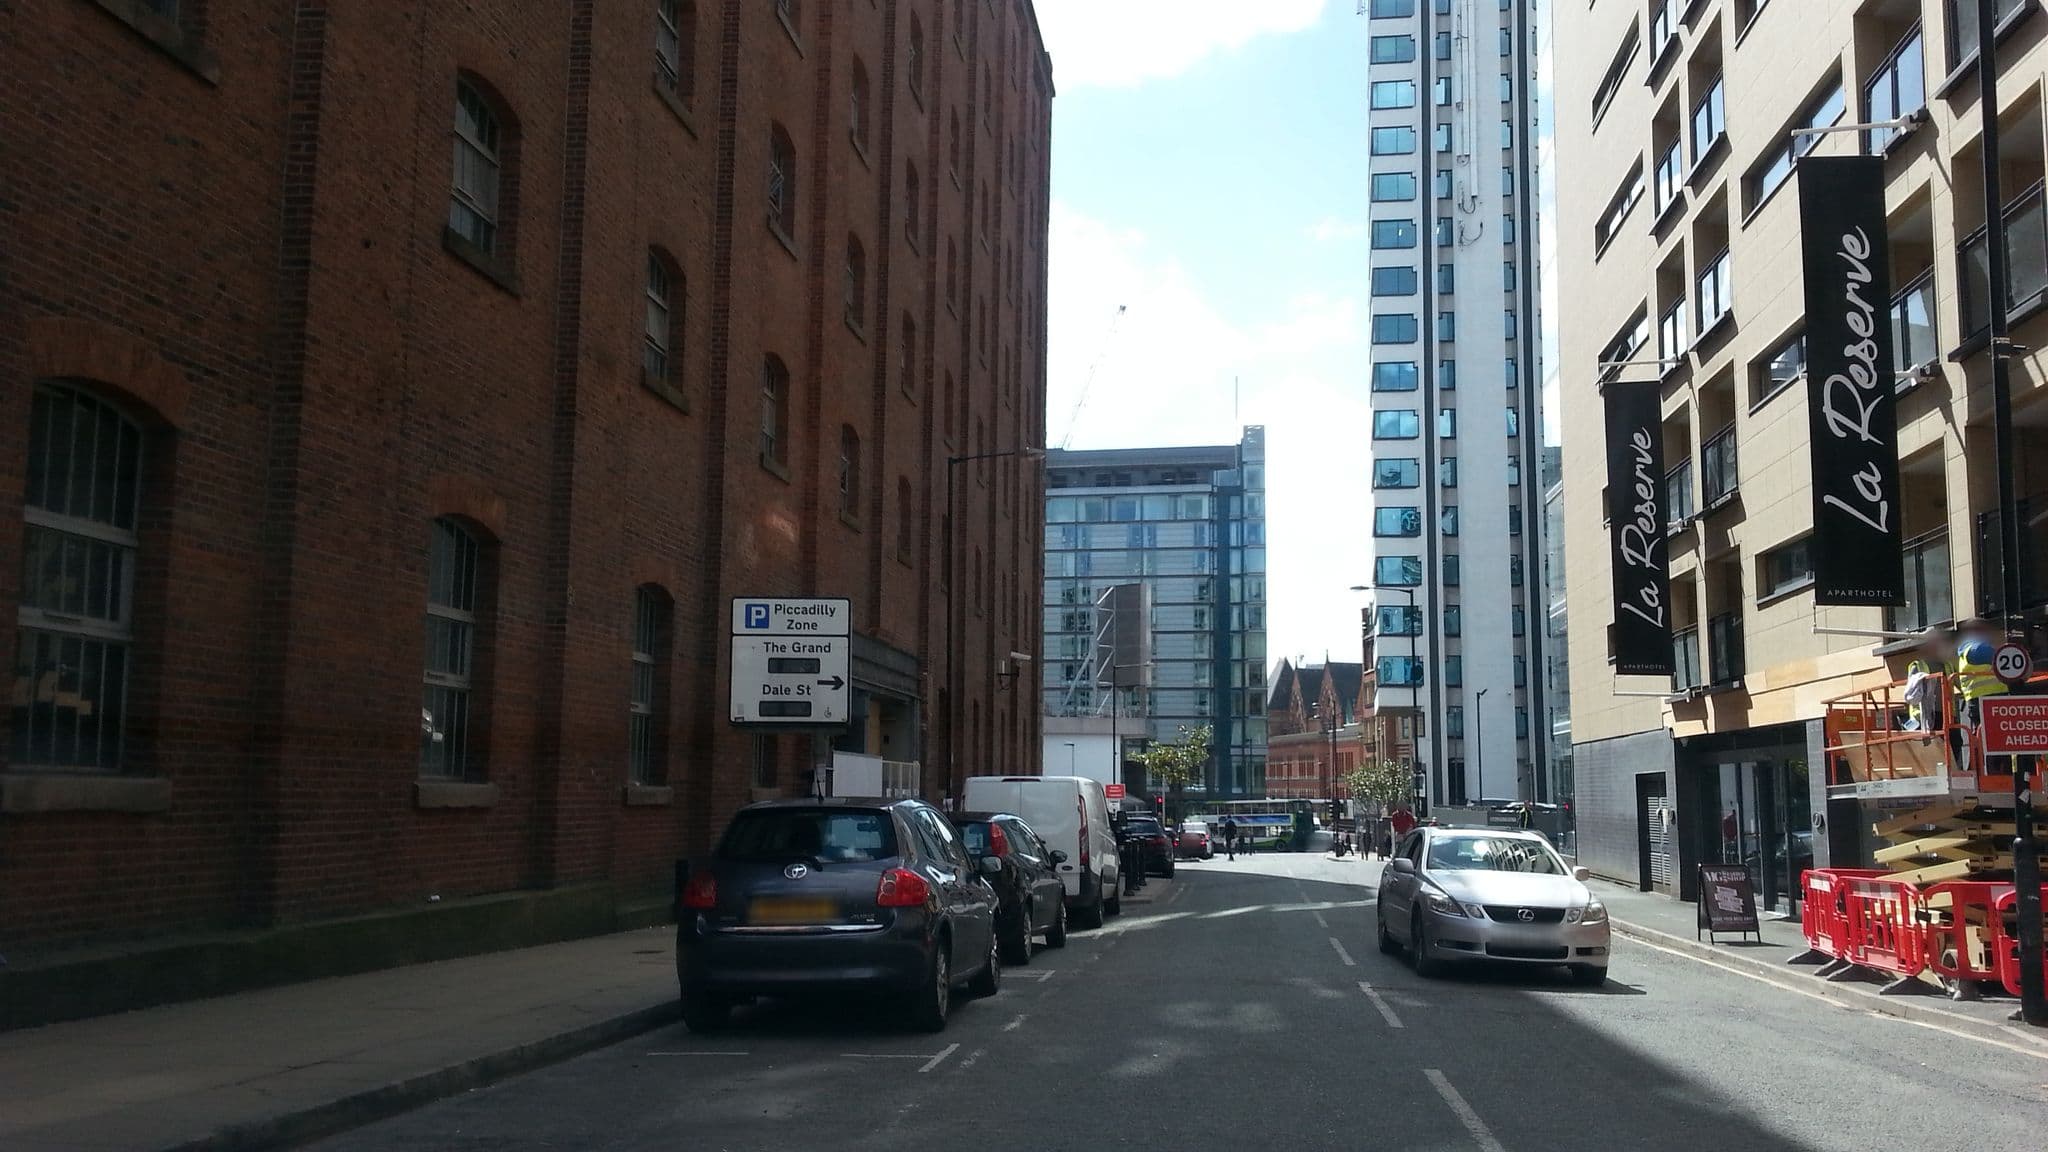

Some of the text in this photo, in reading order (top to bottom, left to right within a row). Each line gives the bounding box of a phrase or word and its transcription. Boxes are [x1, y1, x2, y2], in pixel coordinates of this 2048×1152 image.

[1822, 225, 1890, 534] La Reserve
[1620, 426, 1664, 628] La Reserve
[1826, 588, 1894, 599] APARTHOTEL
[751, 606, 767, 627] P
[774, 603, 836, 618] Piccadilly
[786, 619, 818, 631] Zone
[764, 641, 831, 654] The Grand
[1999, 653, 2025, 671] 20
[762, 684, 812, 696] Dale St
[1991, 705, 2048, 717] FOOTPAT
[2005, 734, 2048, 746] AHEAD
